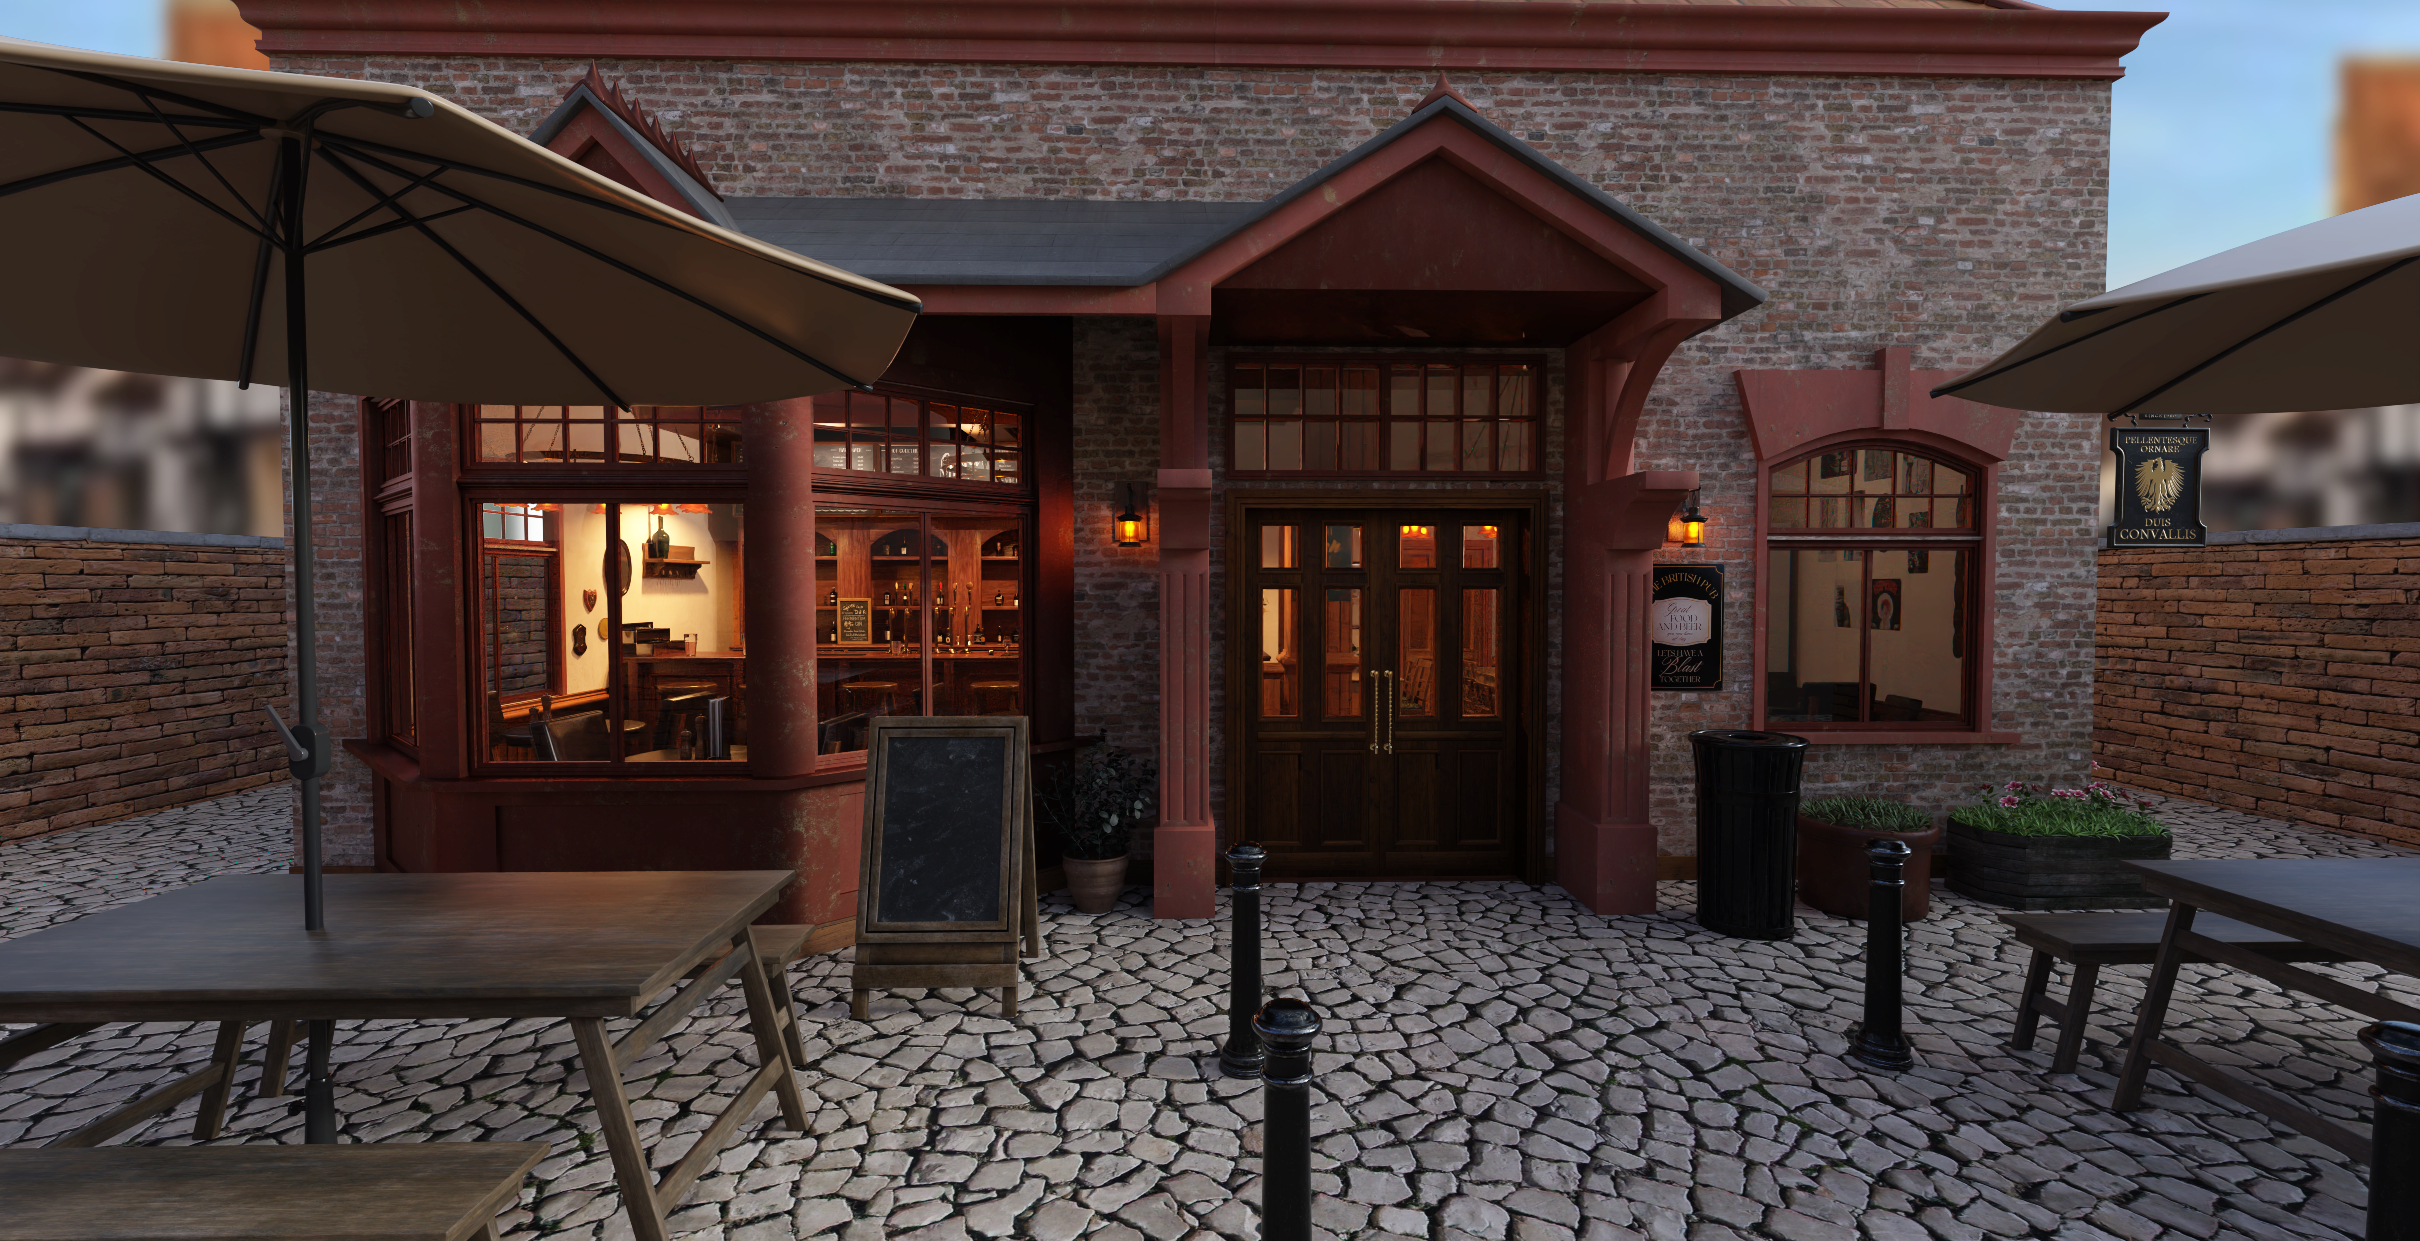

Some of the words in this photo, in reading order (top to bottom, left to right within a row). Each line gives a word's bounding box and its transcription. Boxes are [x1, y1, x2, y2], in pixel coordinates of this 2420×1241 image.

[2125, 436, 2198, 446] PELLENTESQUE
[2140, 445, 2180, 453] ORNARE
[2145, 518, 2171, 527] DUIS
[2120, 529, 2197, 540] CONVALLIS
[1661, 572, 1702, 586] BRITISH
[1700, 579, 1719, 600] PUB
[1663, 602, 1692, 617] Great
[1670, 614, 1698, 622] FOOD
[1697, 649, 1704, 657] A
[1658, 656, 1704, 678] Blast
[1660, 675, 1701, 683] TOGETHER
